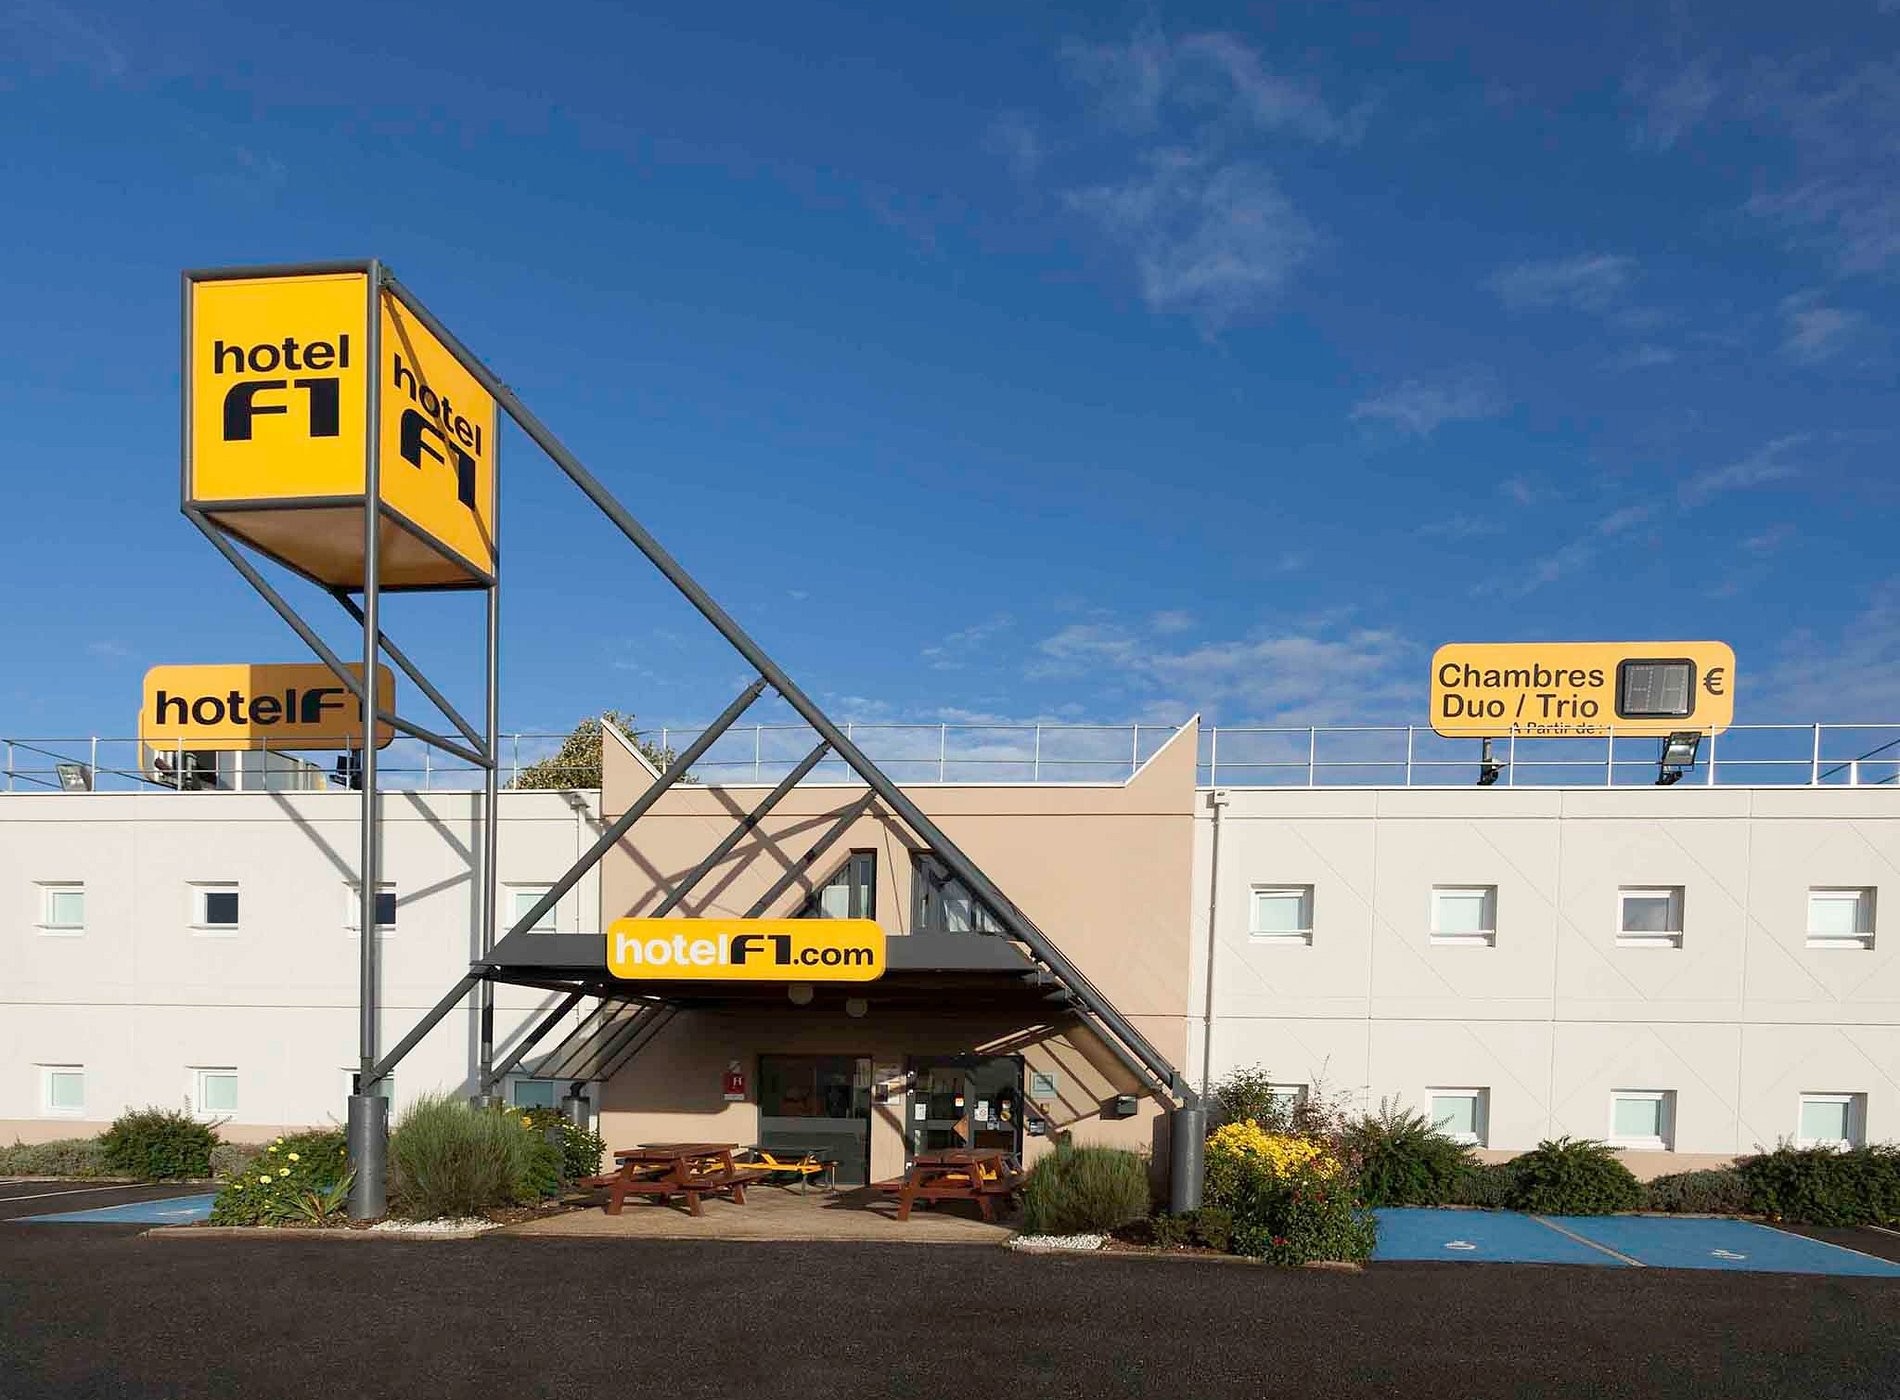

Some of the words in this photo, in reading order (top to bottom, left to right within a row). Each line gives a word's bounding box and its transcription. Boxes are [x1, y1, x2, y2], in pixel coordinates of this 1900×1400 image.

[214, 334, 350, 375] hotel
[223, 378, 340, 442] F1
[393, 352, 482, 457] hotel
[400, 408, 477, 513] F1
[1438, 663, 1604, 688] Chambres
[1703, 667, 1725, 696] €
[155, 687, 364, 726] hotelF
[1442, 693, 1506, 719] Duo
[1515, 693, 1526, 718] /
[1537, 693, 1599, 719] Trio
[1527, 721, 1572, 734] Partir
[615, 933, 874, 967] hotelF1.com
